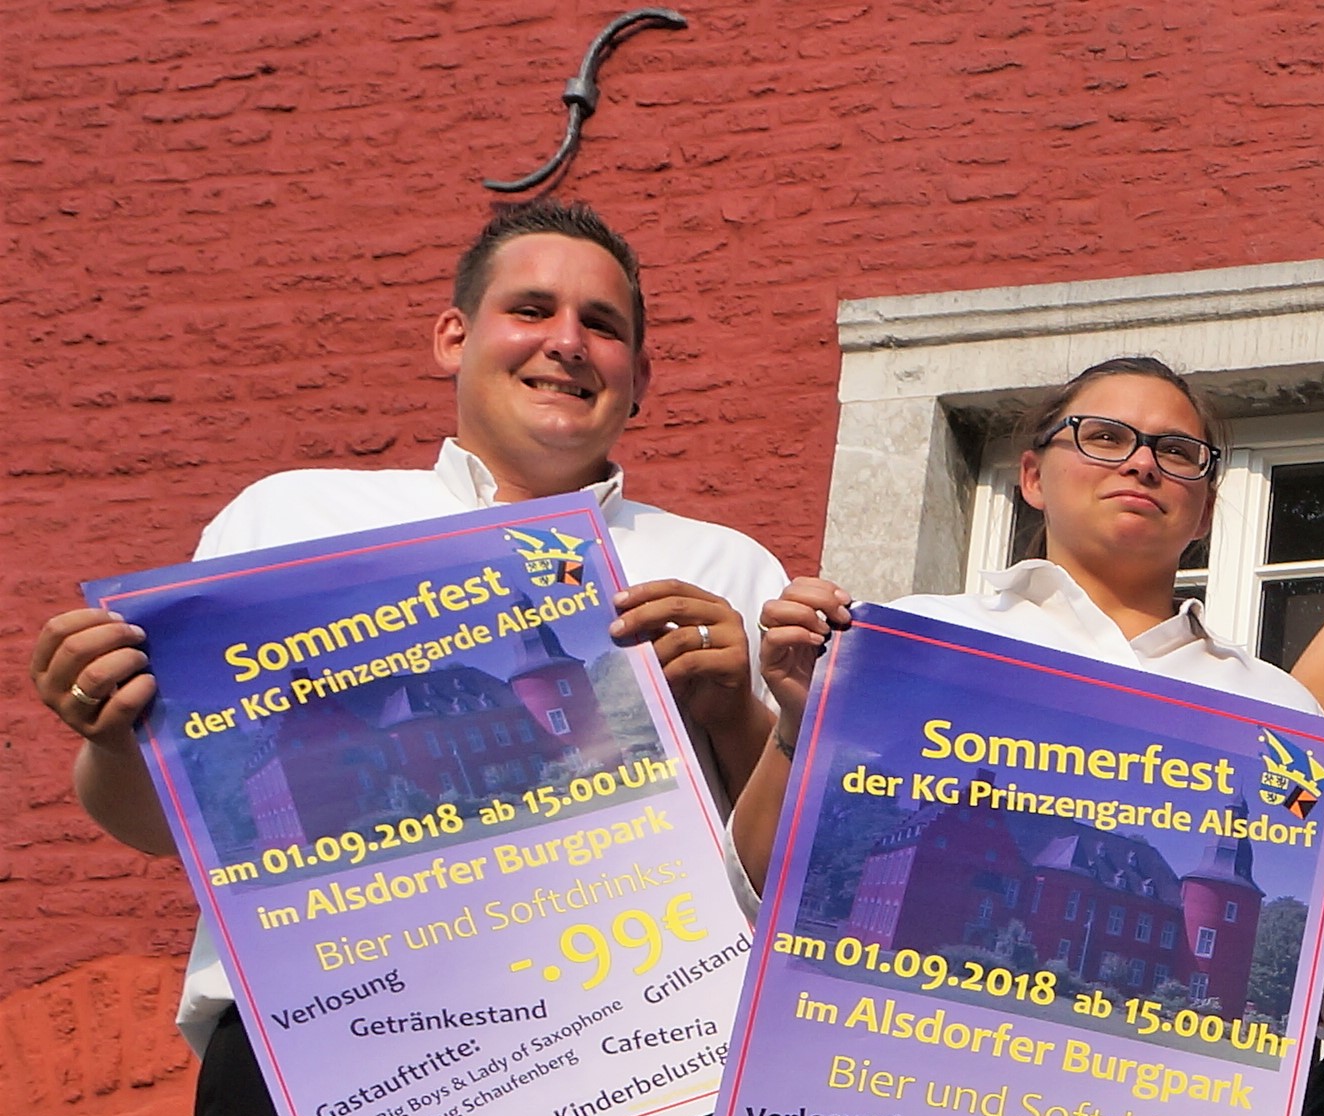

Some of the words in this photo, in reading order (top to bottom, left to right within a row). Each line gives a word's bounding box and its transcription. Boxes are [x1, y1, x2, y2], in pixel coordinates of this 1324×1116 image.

[185, 709, 234, 738] der
[242, 688, 290, 719] KG
[291, 625, 491, 703] Prinzengarde
[498, 584, 598, 635] Alsdorf
[225, 568, 509, 681] Sommerfest
[843, 766, 902, 796] der
[912, 775, 959, 803] KG
[970, 781, 1191, 831] Prinzengarde
[1199, 810, 1316, 846] Alsdorf
[922, 720, 1233, 794] Sommerfest
[211, 862, 258, 885] am
[262, 804, 464, 873] 01.09.2018
[480, 800, 516, 825] ab
[523, 772, 617, 817] 15.00
[618, 758, 682, 789] Uhr
[258, 908, 299, 928] im
[307, 858, 486, 919] Alsdorfer
[494, 807, 672, 873] Burgpark
[316, 935, 390, 970] Bier
[404, 909, 477, 949] und
[485, 860, 687, 930] Softdrinks:
[509, 892, 709, 991] -.99€
[271, 969, 405, 1029] Verlosung
[350, 999, 547, 1036] Getränkestand
[644, 932, 752, 1004] Grillstand
[773, 933, 825, 959] am
[835, 938, 1056, 1005] 01.09.2018
[1073, 991, 1112, 1018] ab
[1125, 999, 1225, 1043] 15.00
[1228, 1019, 1297, 1057] Uhr
[407, 1087, 450, 1111] Boys
[451, 1078, 468, 1090] &
[467, 1058, 507, 1082] Lady
[512, 1043, 529, 1061] of
[531, 1001, 623, 1052] Saxophone
[462, 1049, 579, 1112] Schaufenberg
[602, 1019, 717, 1054] Cafeteria
[796, 993, 838, 1024] im
[845, 998, 1055, 1064] Alsdorfer
[1062, 1040, 1253, 1109] Burgpark
[828, 1056, 915, 1098] Bier
